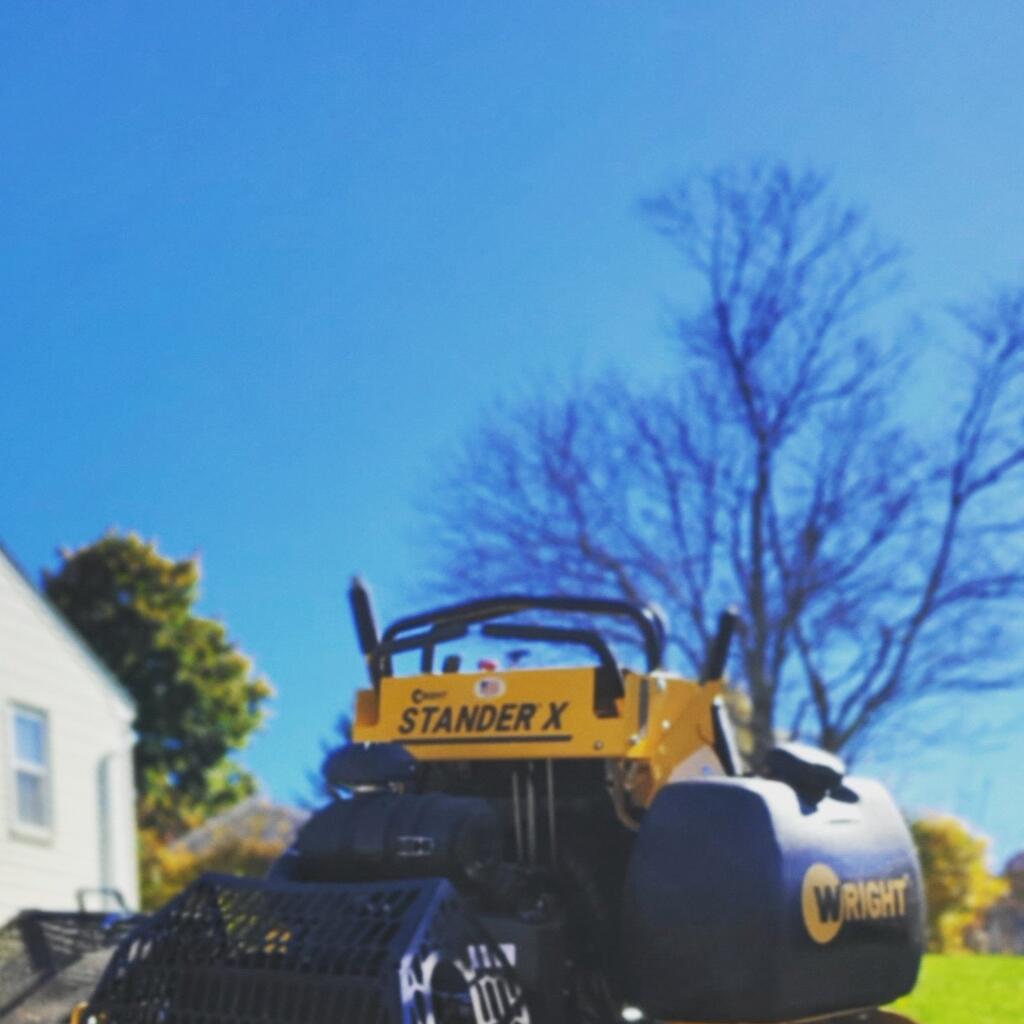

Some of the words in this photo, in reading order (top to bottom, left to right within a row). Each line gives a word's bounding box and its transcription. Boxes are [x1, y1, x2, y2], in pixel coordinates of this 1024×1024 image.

[399, 703, 536, 734] STANDER
[542, 702, 569, 730] X
[812, 876, 908, 924] WRIGHT
